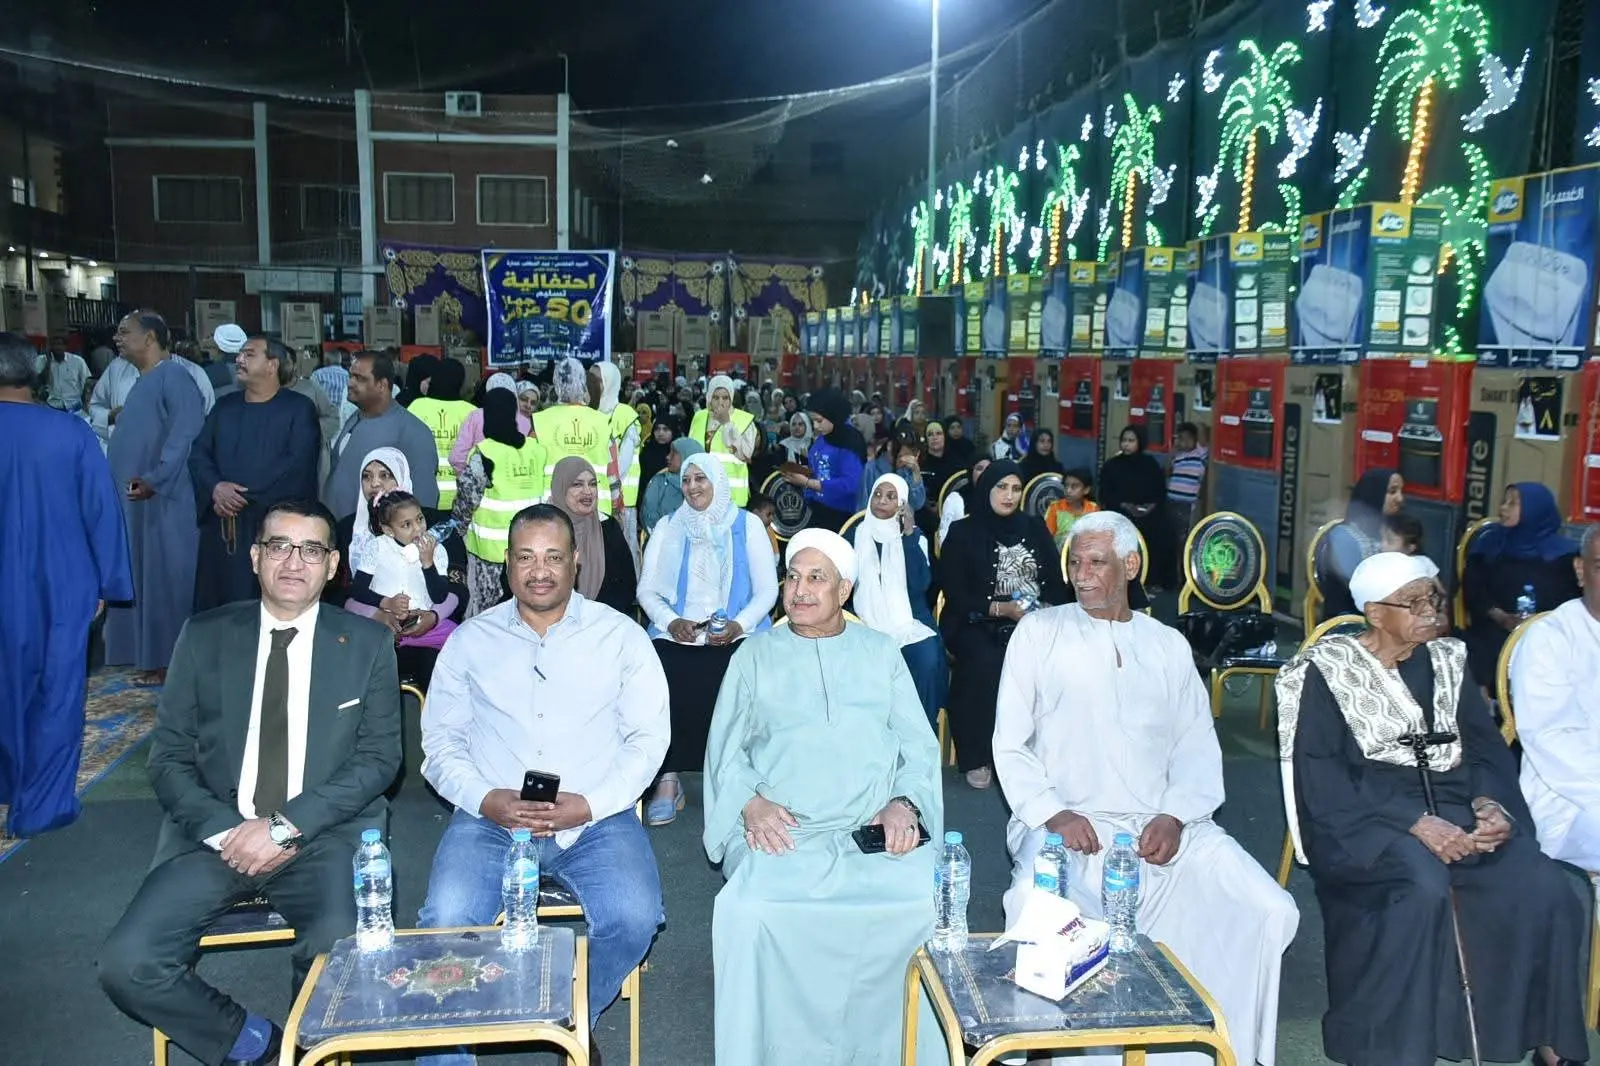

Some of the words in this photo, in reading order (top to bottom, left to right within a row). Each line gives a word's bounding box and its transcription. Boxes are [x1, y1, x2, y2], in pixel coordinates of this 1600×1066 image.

[502, 270, 596, 291] احتفالية
[564, 432, 592, 447] الرحمة
[1280, 425, 1297, 537] unionaire
